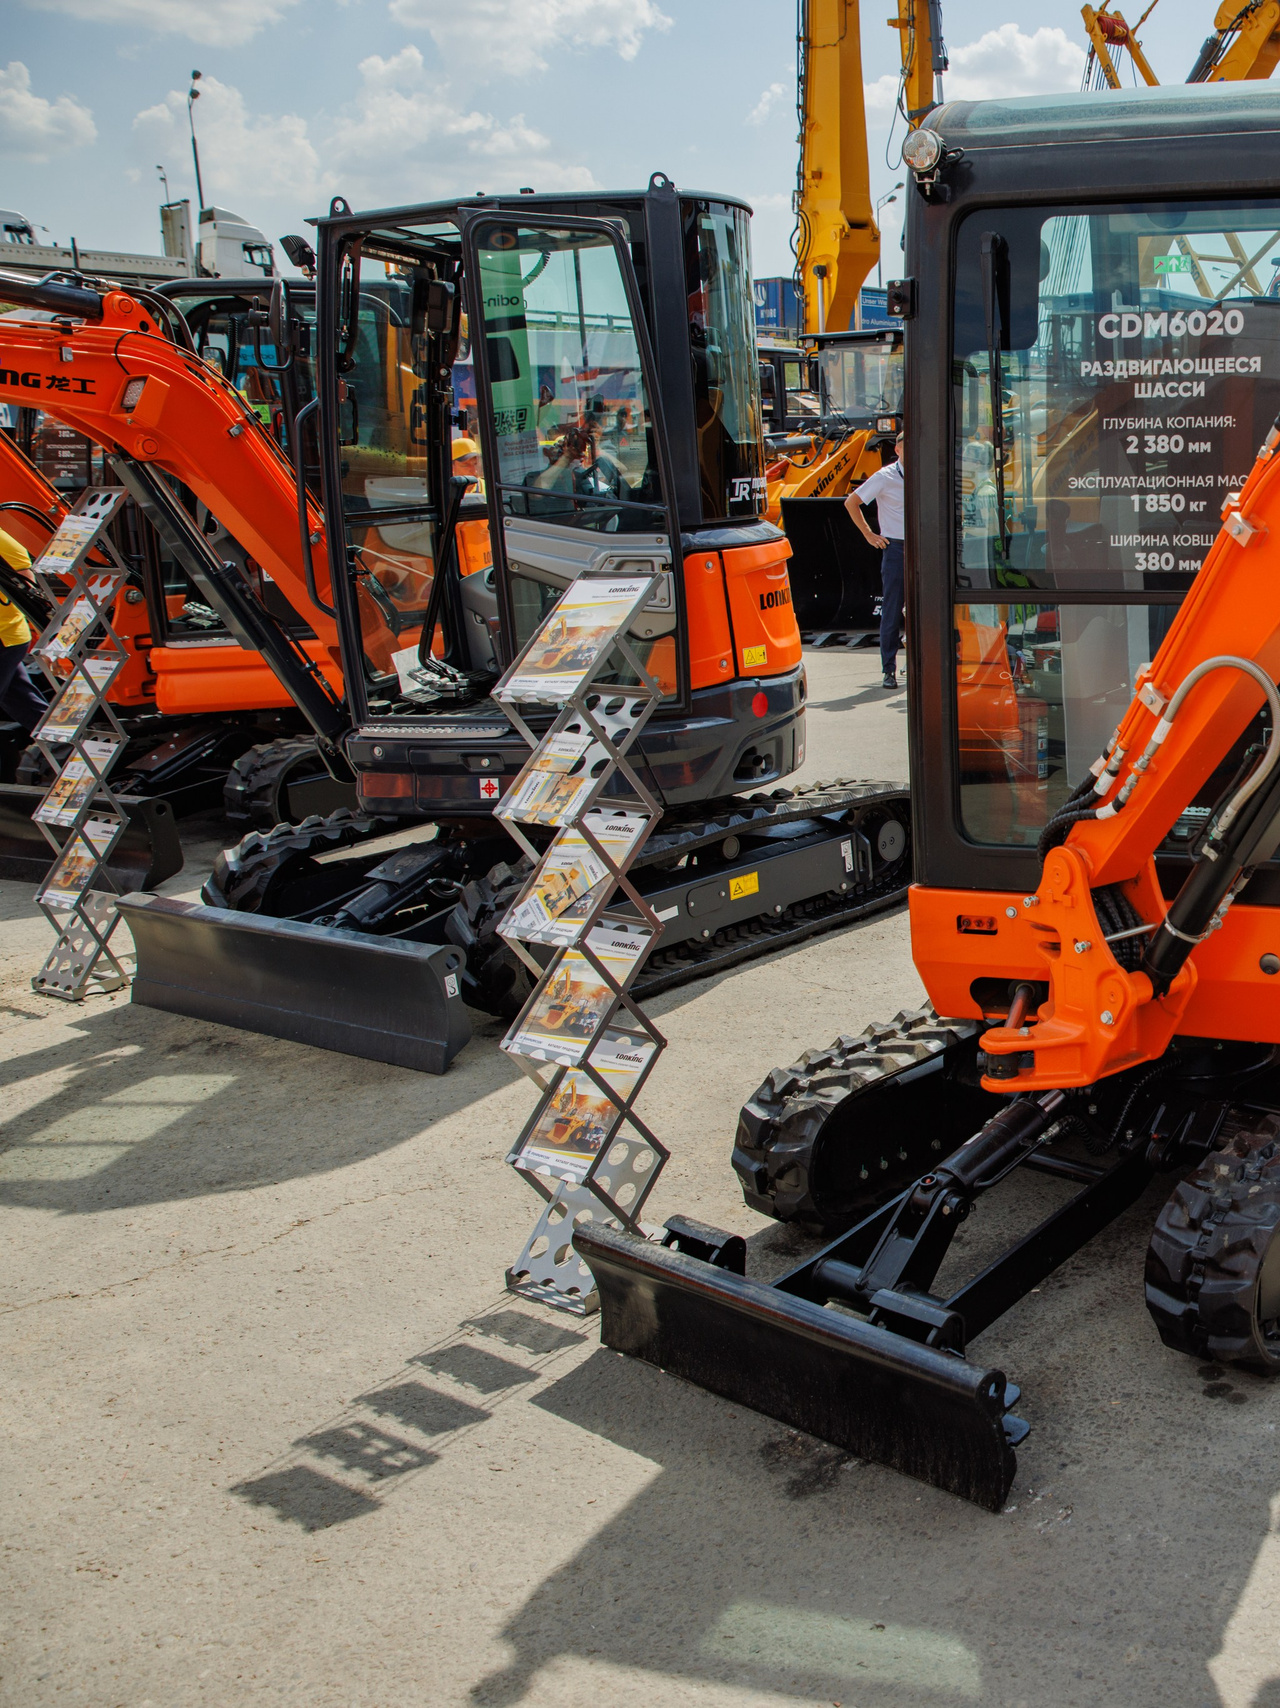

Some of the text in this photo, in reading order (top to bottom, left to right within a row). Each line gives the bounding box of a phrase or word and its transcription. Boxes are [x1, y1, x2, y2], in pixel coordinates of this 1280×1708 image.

[1099, 309, 1244, 339] CDM6020
[1080, 357, 1261, 379] РАЗДВИГАЮЩЕЕСЯ
[1134, 381, 1205, 398] ШАССИ
[1103, 416, 1236, 429] ГЛУБИНА КОПАНИЯ:
[1126, 434, 1211, 453] 2 380 мм
[1068, 475, 1214, 489] ЭКСПЛУАТАЦИОННАЯ
[1131, 493, 1207, 512] 1 850 кг
[1110, 534, 1217, 547] ШИРИНА КОВШ
[1134, 552, 1202, 571] 380 мм
[605, 824, 635, 833] LONKING
[611, 941, 641, 951] LONKING
[615, 1053, 643, 1063] LONKING
